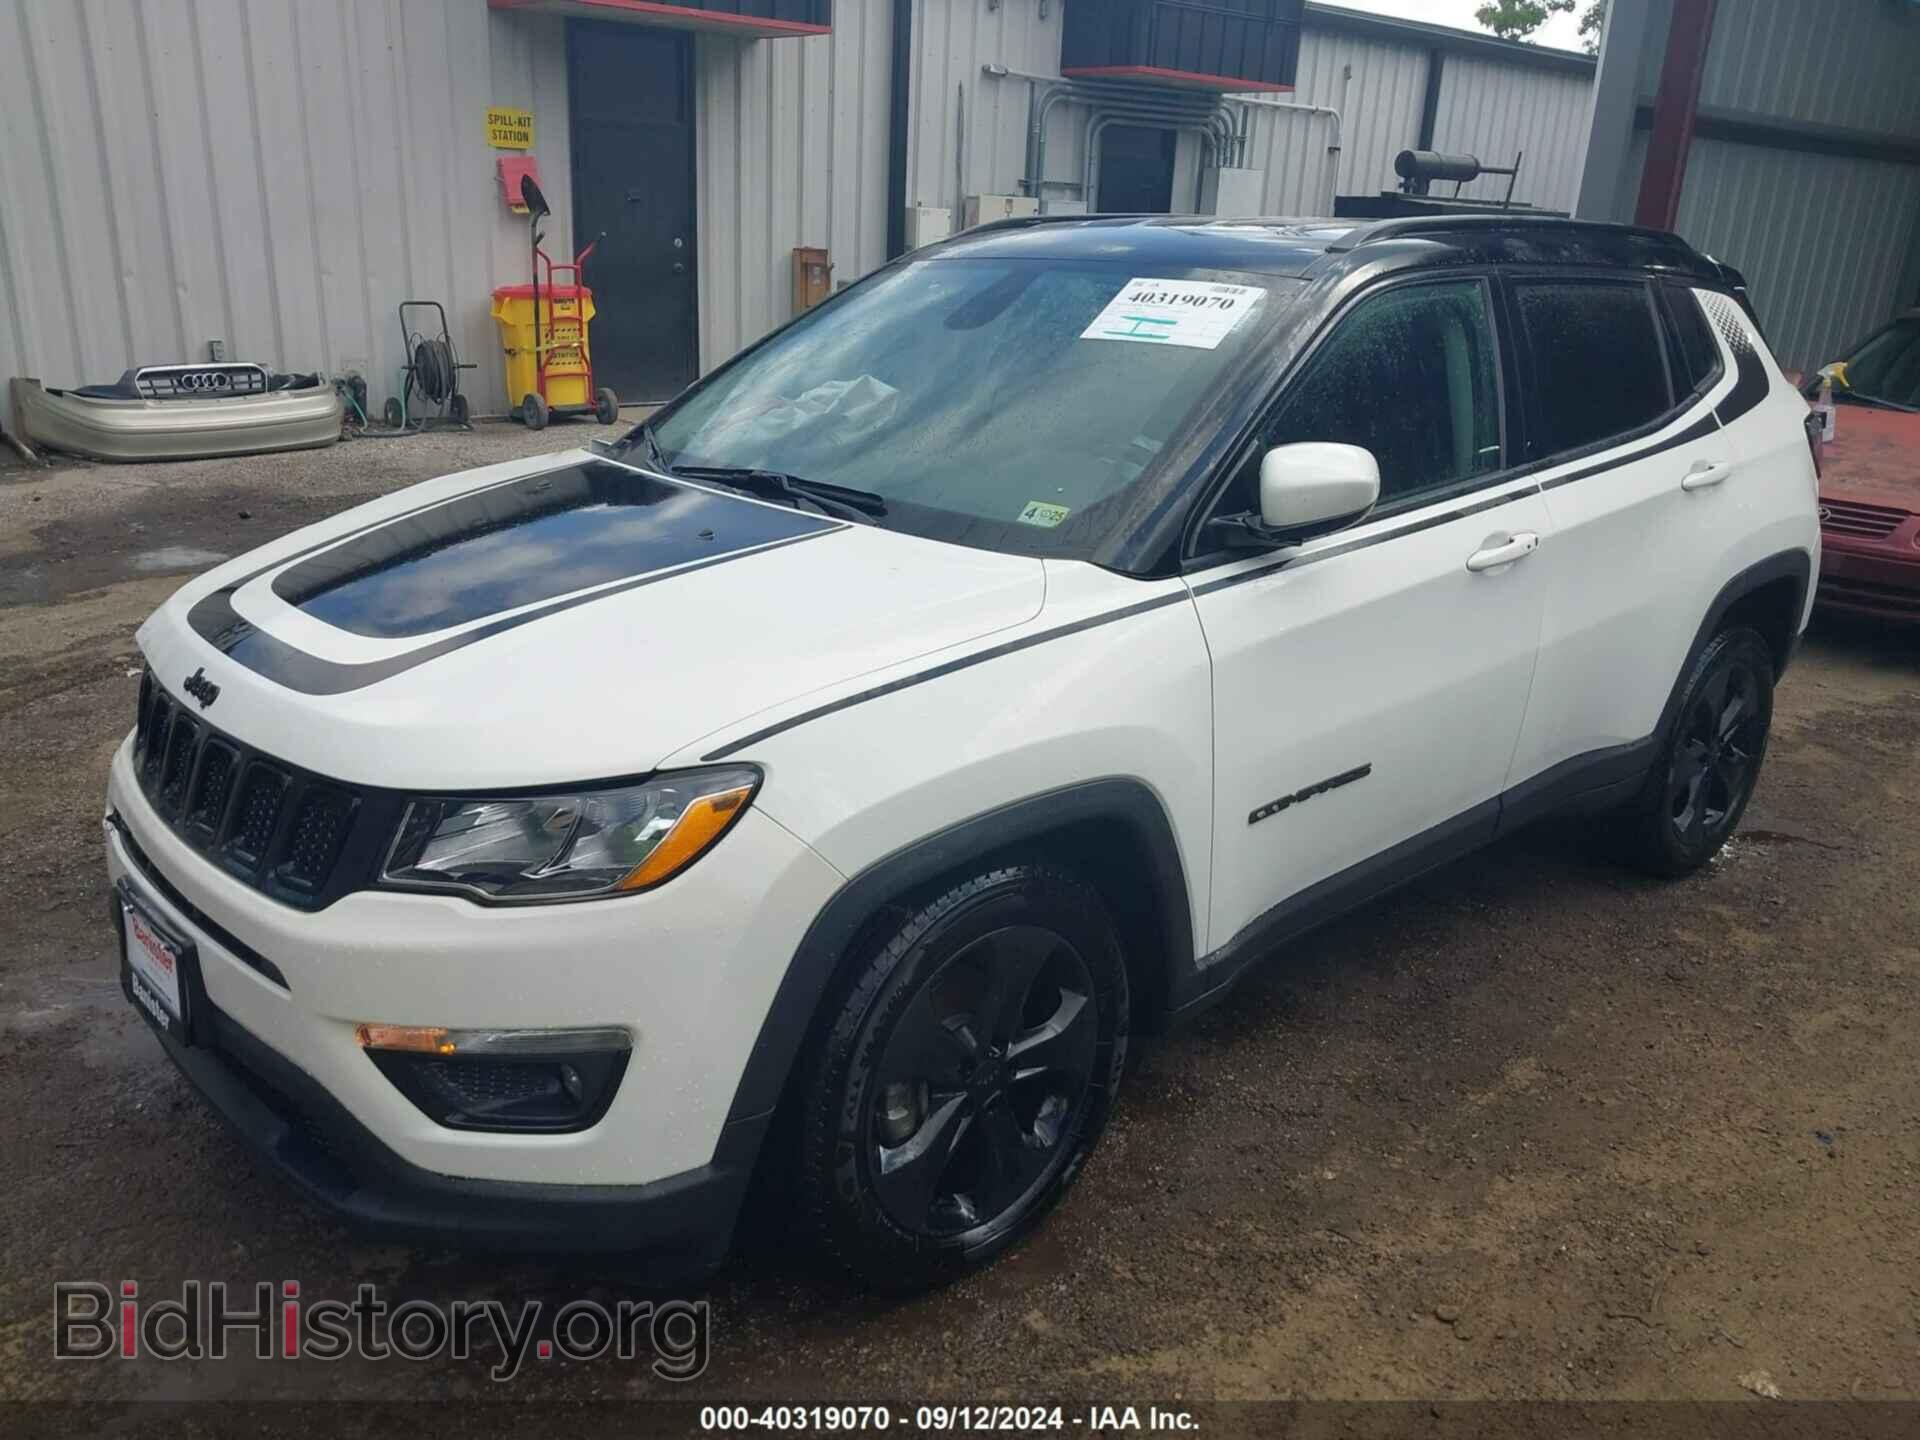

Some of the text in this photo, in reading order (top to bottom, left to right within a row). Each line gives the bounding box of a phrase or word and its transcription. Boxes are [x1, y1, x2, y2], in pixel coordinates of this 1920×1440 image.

[488, 113, 532, 127] SPILL-KIT
[492, 129, 529, 142] STATION
[1128, 291, 1235, 311] 40319070
[1024, 506, 1039, 520] 4
